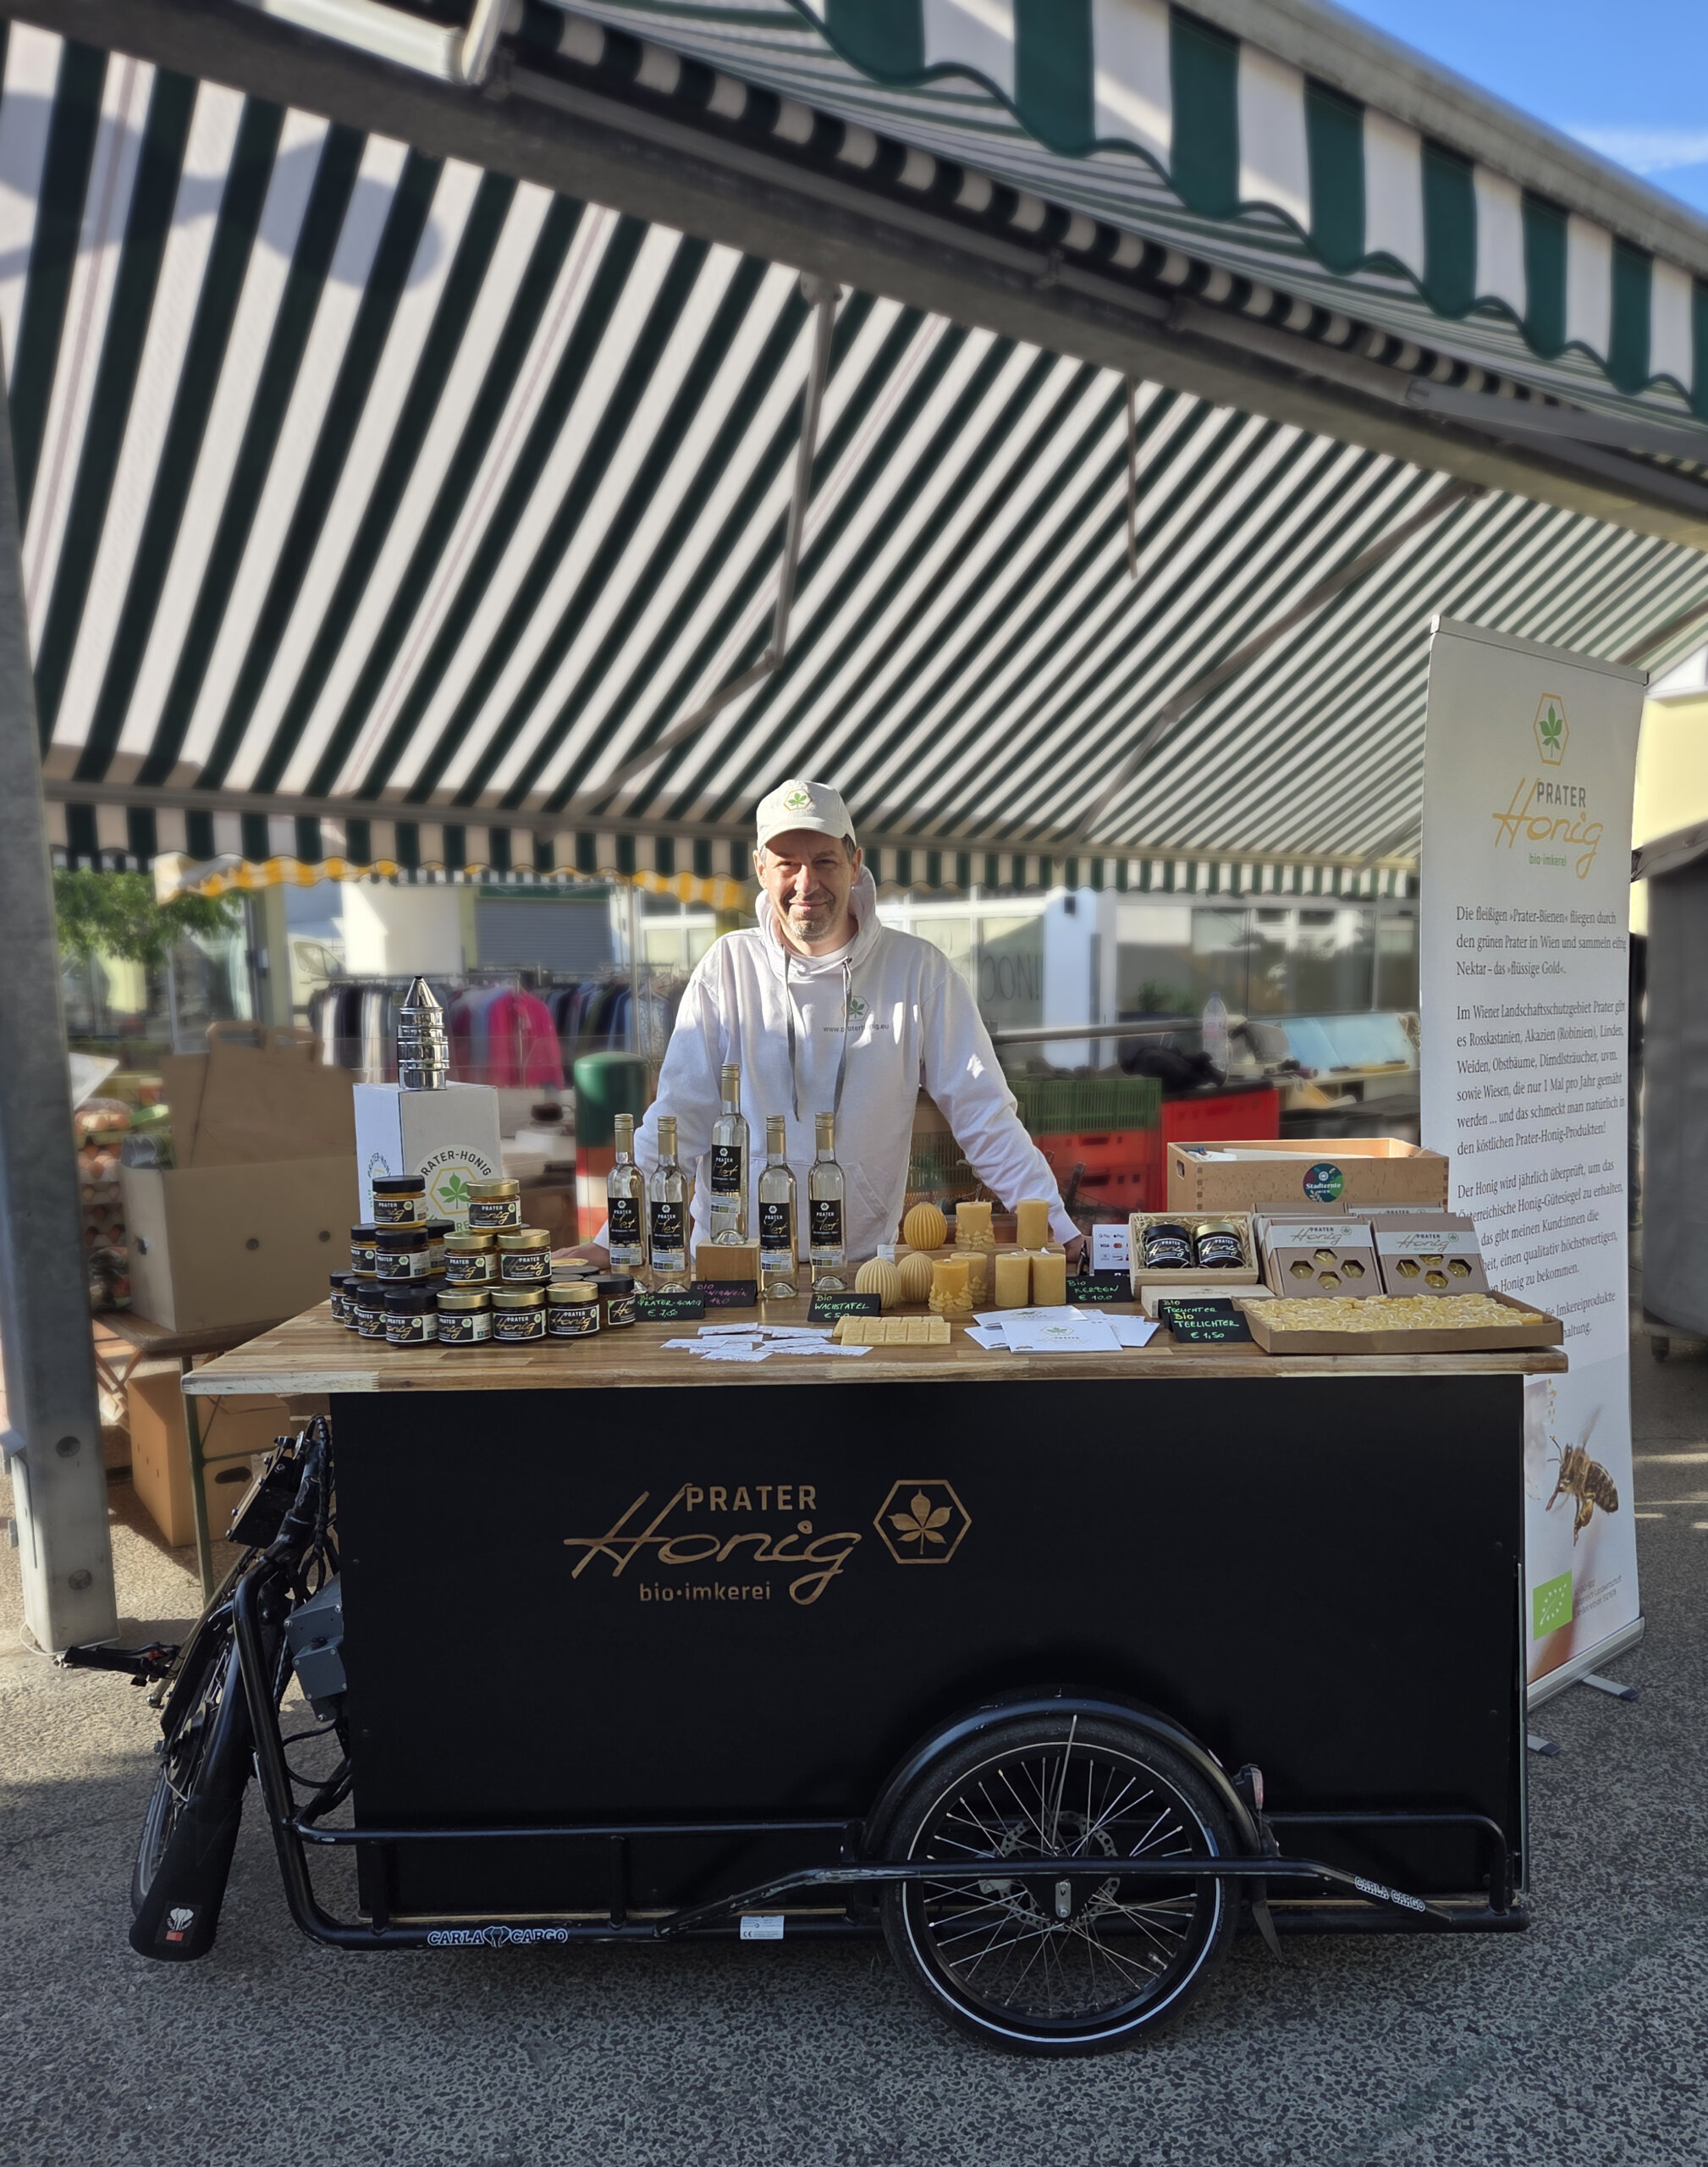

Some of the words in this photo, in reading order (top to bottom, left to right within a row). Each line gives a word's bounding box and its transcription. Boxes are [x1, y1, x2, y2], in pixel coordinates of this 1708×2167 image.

[1537, 781, 1586, 808] PRATER
[1492, 777, 1604, 880] Honig
[1457, 907, 1474, 920] Die
[1476, 907, 1507, 925] fleißigen
[1570, 910, 1595, 927] fliegen
[1597, 912, 1616, 924] durch
[1457, 934, 1474, 948] den
[1477, 935, 1503, 951] grünen
[1505, 935, 1527, 948] Prater
[1529, 935, 1538, 948] in
[1540, 935, 1560, 948] Wien
[1562, 936, 1576, 948] und
[1579, 936, 1611, 949] sammeln
[1457, 962, 1486, 975] Nektar
[1494, 962, 1505, 975] das
[1457, 1006, 1470, 1020] Im
[1474, 1005, 1499, 1018] Wiener
[1501, 1001, 1591, 1017] Landschaftsschutzgebiet
[1594, 1000, 1613, 1013] Prater
[1457, 1036, 1467, 1047] es
[1469, 1030, 1523, 1046] Rosskastanien,
[1524, 1028, 1556, 1043] Akazien
[1557, 1026, 1598, 1042] (Robinien),
[1457, 1060, 1490, 1074] Weiden,
[1492, 1056, 1537, 1072] Obstbäume,
[1540, 1052, 1599, 1067] Dirndlsträucher,
[1457, 1088, 1481, 1101] sowie
[1483, 1084, 1511, 1099] Wiesen,
[1512, 1082, 1525, 1095] die
[1527, 1083, 1541, 1094] nur
[1544, 1079, 1548, 1092] 1
[1550, 1078, 1564, 1091] Mal
[1566, 1078, 1578, 1093] pro
[1579, 1075, 1595, 1089] Jahr
[1597, 1072, 1623, 1089] gemäht
[1457, 1114, 1488, 1128] werden
[1499, 1109, 1513, 1122] und
[1516, 1107, 1529, 1120] das
[1530, 1103, 1566, 1118] schmeckt
[1567, 1102, 1584, 1114] man
[1585, 1098, 1618, 1112] natürlich
[1457, 1141, 1474, 1155] den
[1476, 1137, 1514, 1153] köstlichen
[1515, 1121, 1606, 1147] Prater-Honig-Produkten!
[421, 1150, 492, 1177] RATER-HONIG
[1457, 1184, 1474, 1199] Der
[1475, 1178, 1498, 1196] Honig
[1500, 1175, 1517, 1189] wird
[1518, 1170, 1549, 1190] jährlich
[1550, 1164, 1585, 1182] überprüft,
[1588, 1163, 1601, 1174] um
[1602, 1160, 1614, 1172] das
[1518, 1188, 1581, 1213] Honig-Gütesiegel
[1583, 1188, 1592, 1200] zu
[1593, 1182, 1623, 1198] erhalten,
[1290, 1227, 1343, 1246] Honig
[1481, 1232, 1493, 1247] das
[1495, 1228, 1509, 1247] gibt
[1511, 1224, 1540, 1240] meinen
[1542, 1216, 1585, 1232] Kund:innen
[1587, 1210, 1599, 1221] die
[1397, 1233, 1450, 1252] Honig
[1500, 1252, 1521, 1267] einen
[1523, 1243, 1559, 1261] qualitativ
[1561, 1230, 1617, 1252] höchstwertigen,
[1501, 1276, 1523, 1293] Honig
[1526, 1275, 1535, 1286] zu
[1536, 1263, 1579, 1283] bekommen.
[1556, 1291, 1616, 1316] Imkereiprodukte
[496, 1316, 537, 1336] Honig
[1174, 1320, 1240, 1328] TEELICHTER
[686, 1485, 818, 1512] PRATER
[563, 1482, 862, 1606] Honig
[1354, 1876, 1390, 1900] CARLA
[1391, 1889, 1426, 1912] CARGO
[427, 1930, 485, 1946] CARLA
[510, 1928, 568, 1944] CARGO
